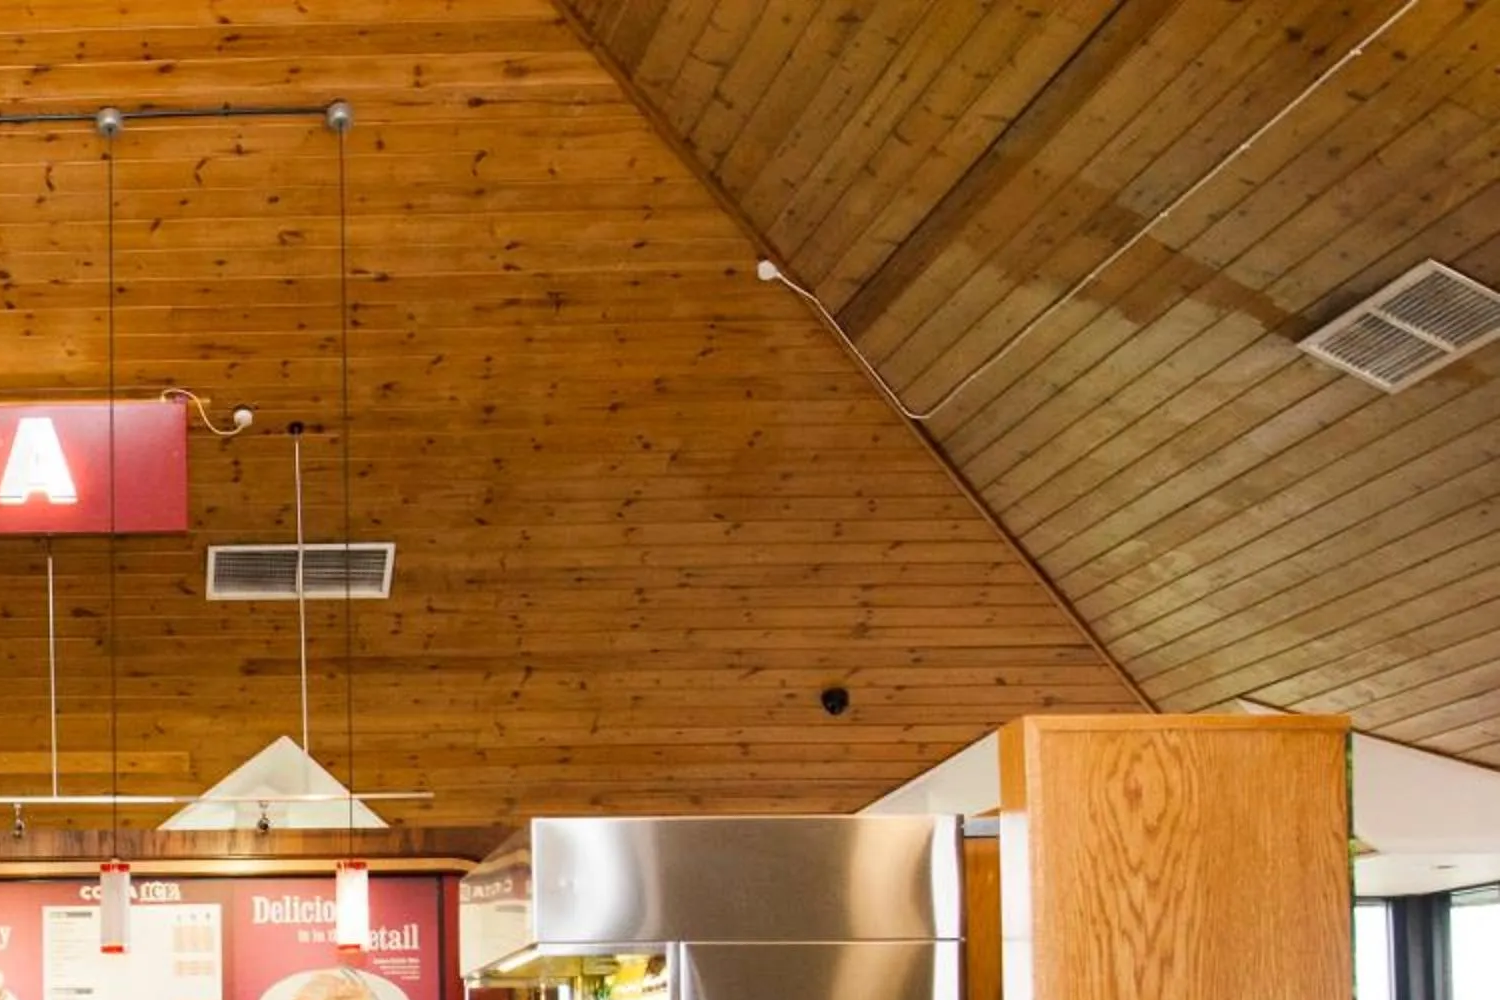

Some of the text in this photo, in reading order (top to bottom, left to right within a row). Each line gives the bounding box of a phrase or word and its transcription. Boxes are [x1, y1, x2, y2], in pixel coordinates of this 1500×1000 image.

[79, 885, 138, 900] COA
[252, 896, 337, 924] Delicio
[368, 924, 420, 950] etail
